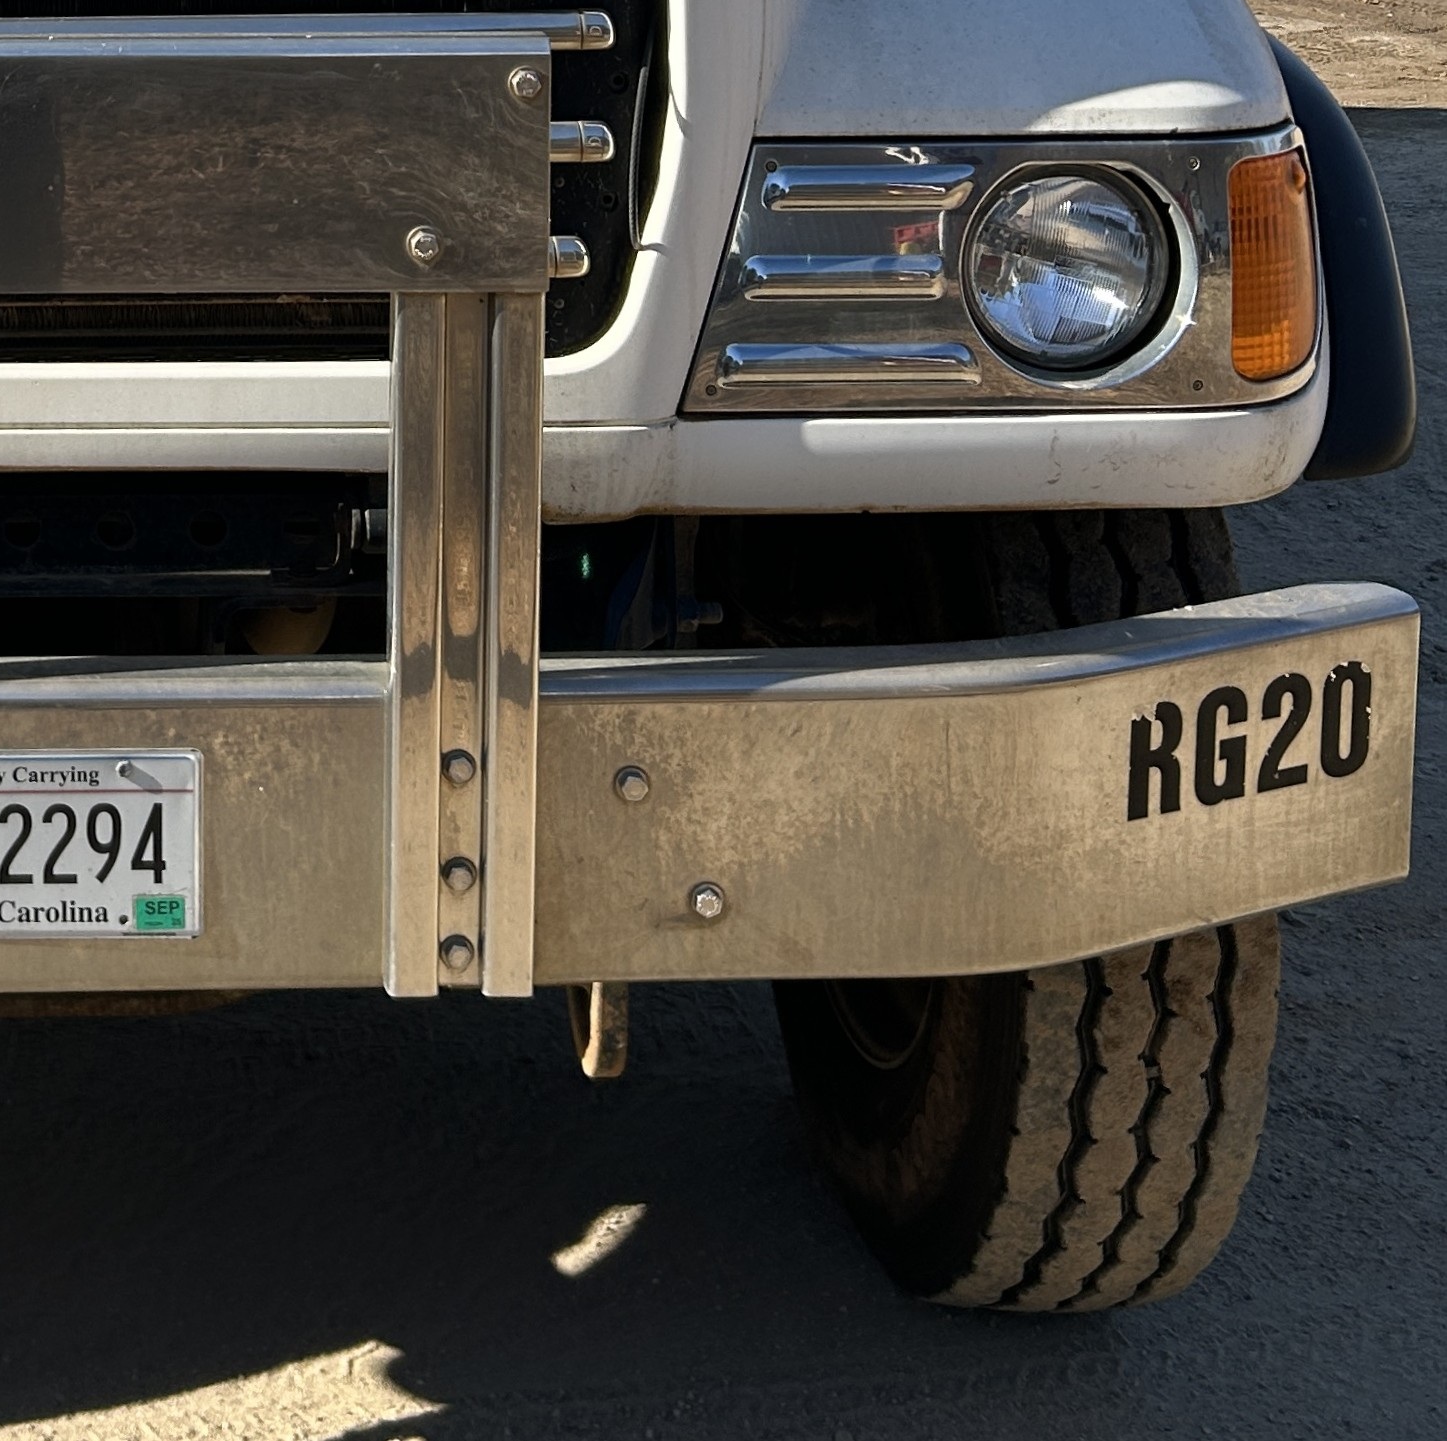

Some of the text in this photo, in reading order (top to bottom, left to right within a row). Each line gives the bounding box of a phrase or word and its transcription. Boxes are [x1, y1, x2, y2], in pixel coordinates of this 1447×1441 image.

[1127, 661, 1372, 821] RG20
[12, 766, 100, 786] Carrying
[144, 900, 180, 915] SEP
